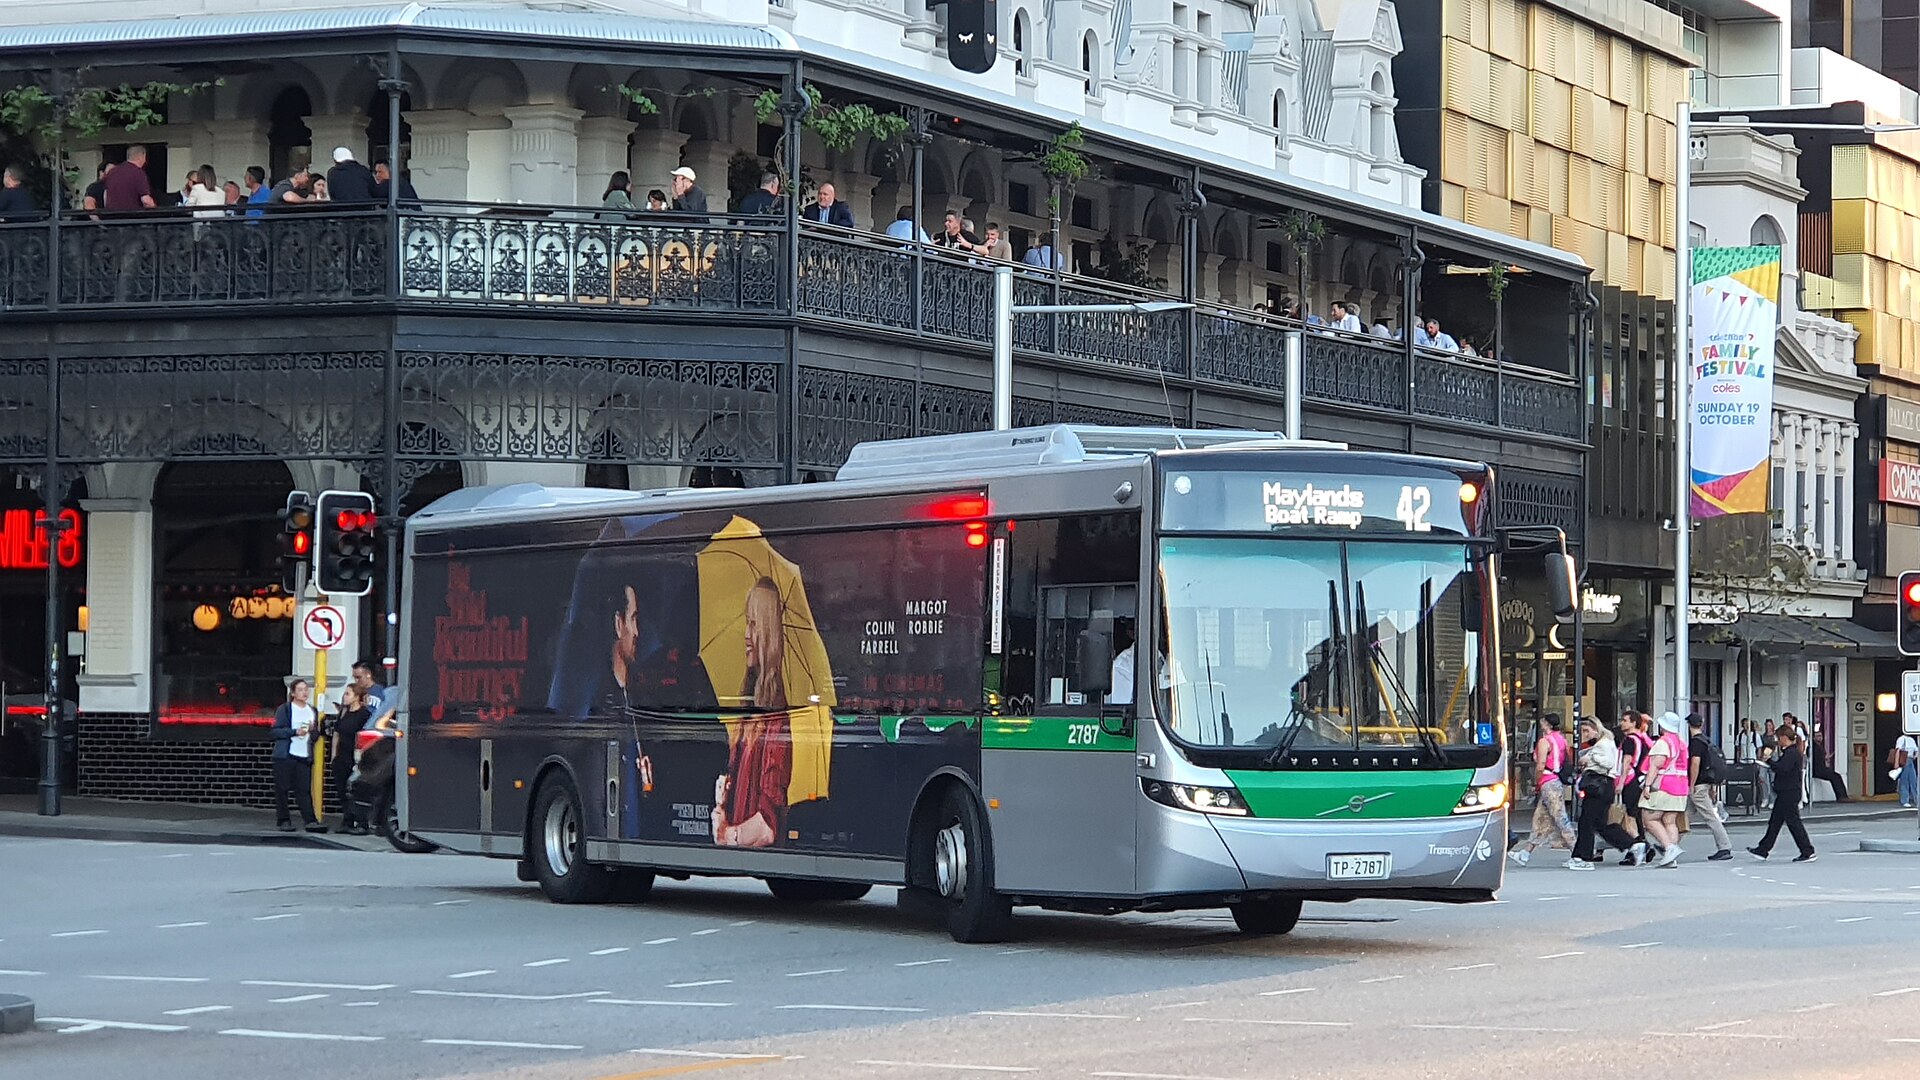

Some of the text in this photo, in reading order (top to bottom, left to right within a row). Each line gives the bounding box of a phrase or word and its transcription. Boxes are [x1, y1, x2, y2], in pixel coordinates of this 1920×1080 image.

[1702, 343, 1760, 360] FAMILY
[1696, 360, 1766, 380] FESTIVAL
[1713, 383, 1741, 393] coles
[1698, 402, 1760, 413] SUNDAY 19
[1699, 414, 1756, 425] OCTOBER
[1263, 481, 1364, 509] Maylands
[1397, 485, 1432, 532] 42
[1265, 505, 1362, 530] Boat Ramp
[905, 600, 947, 616] MARGOT
[865, 621, 895, 636] COLIN
[908, 620, 944, 635] ROBBIE
[861, 640, 899, 654] FARRELL
[1068, 724, 1100, 744] 2787
[1290, 757, 1419, 766] VOLGREN
[1428, 844, 1470, 857] Transperth
[1333, 860, 1383, 875] TP-2787
